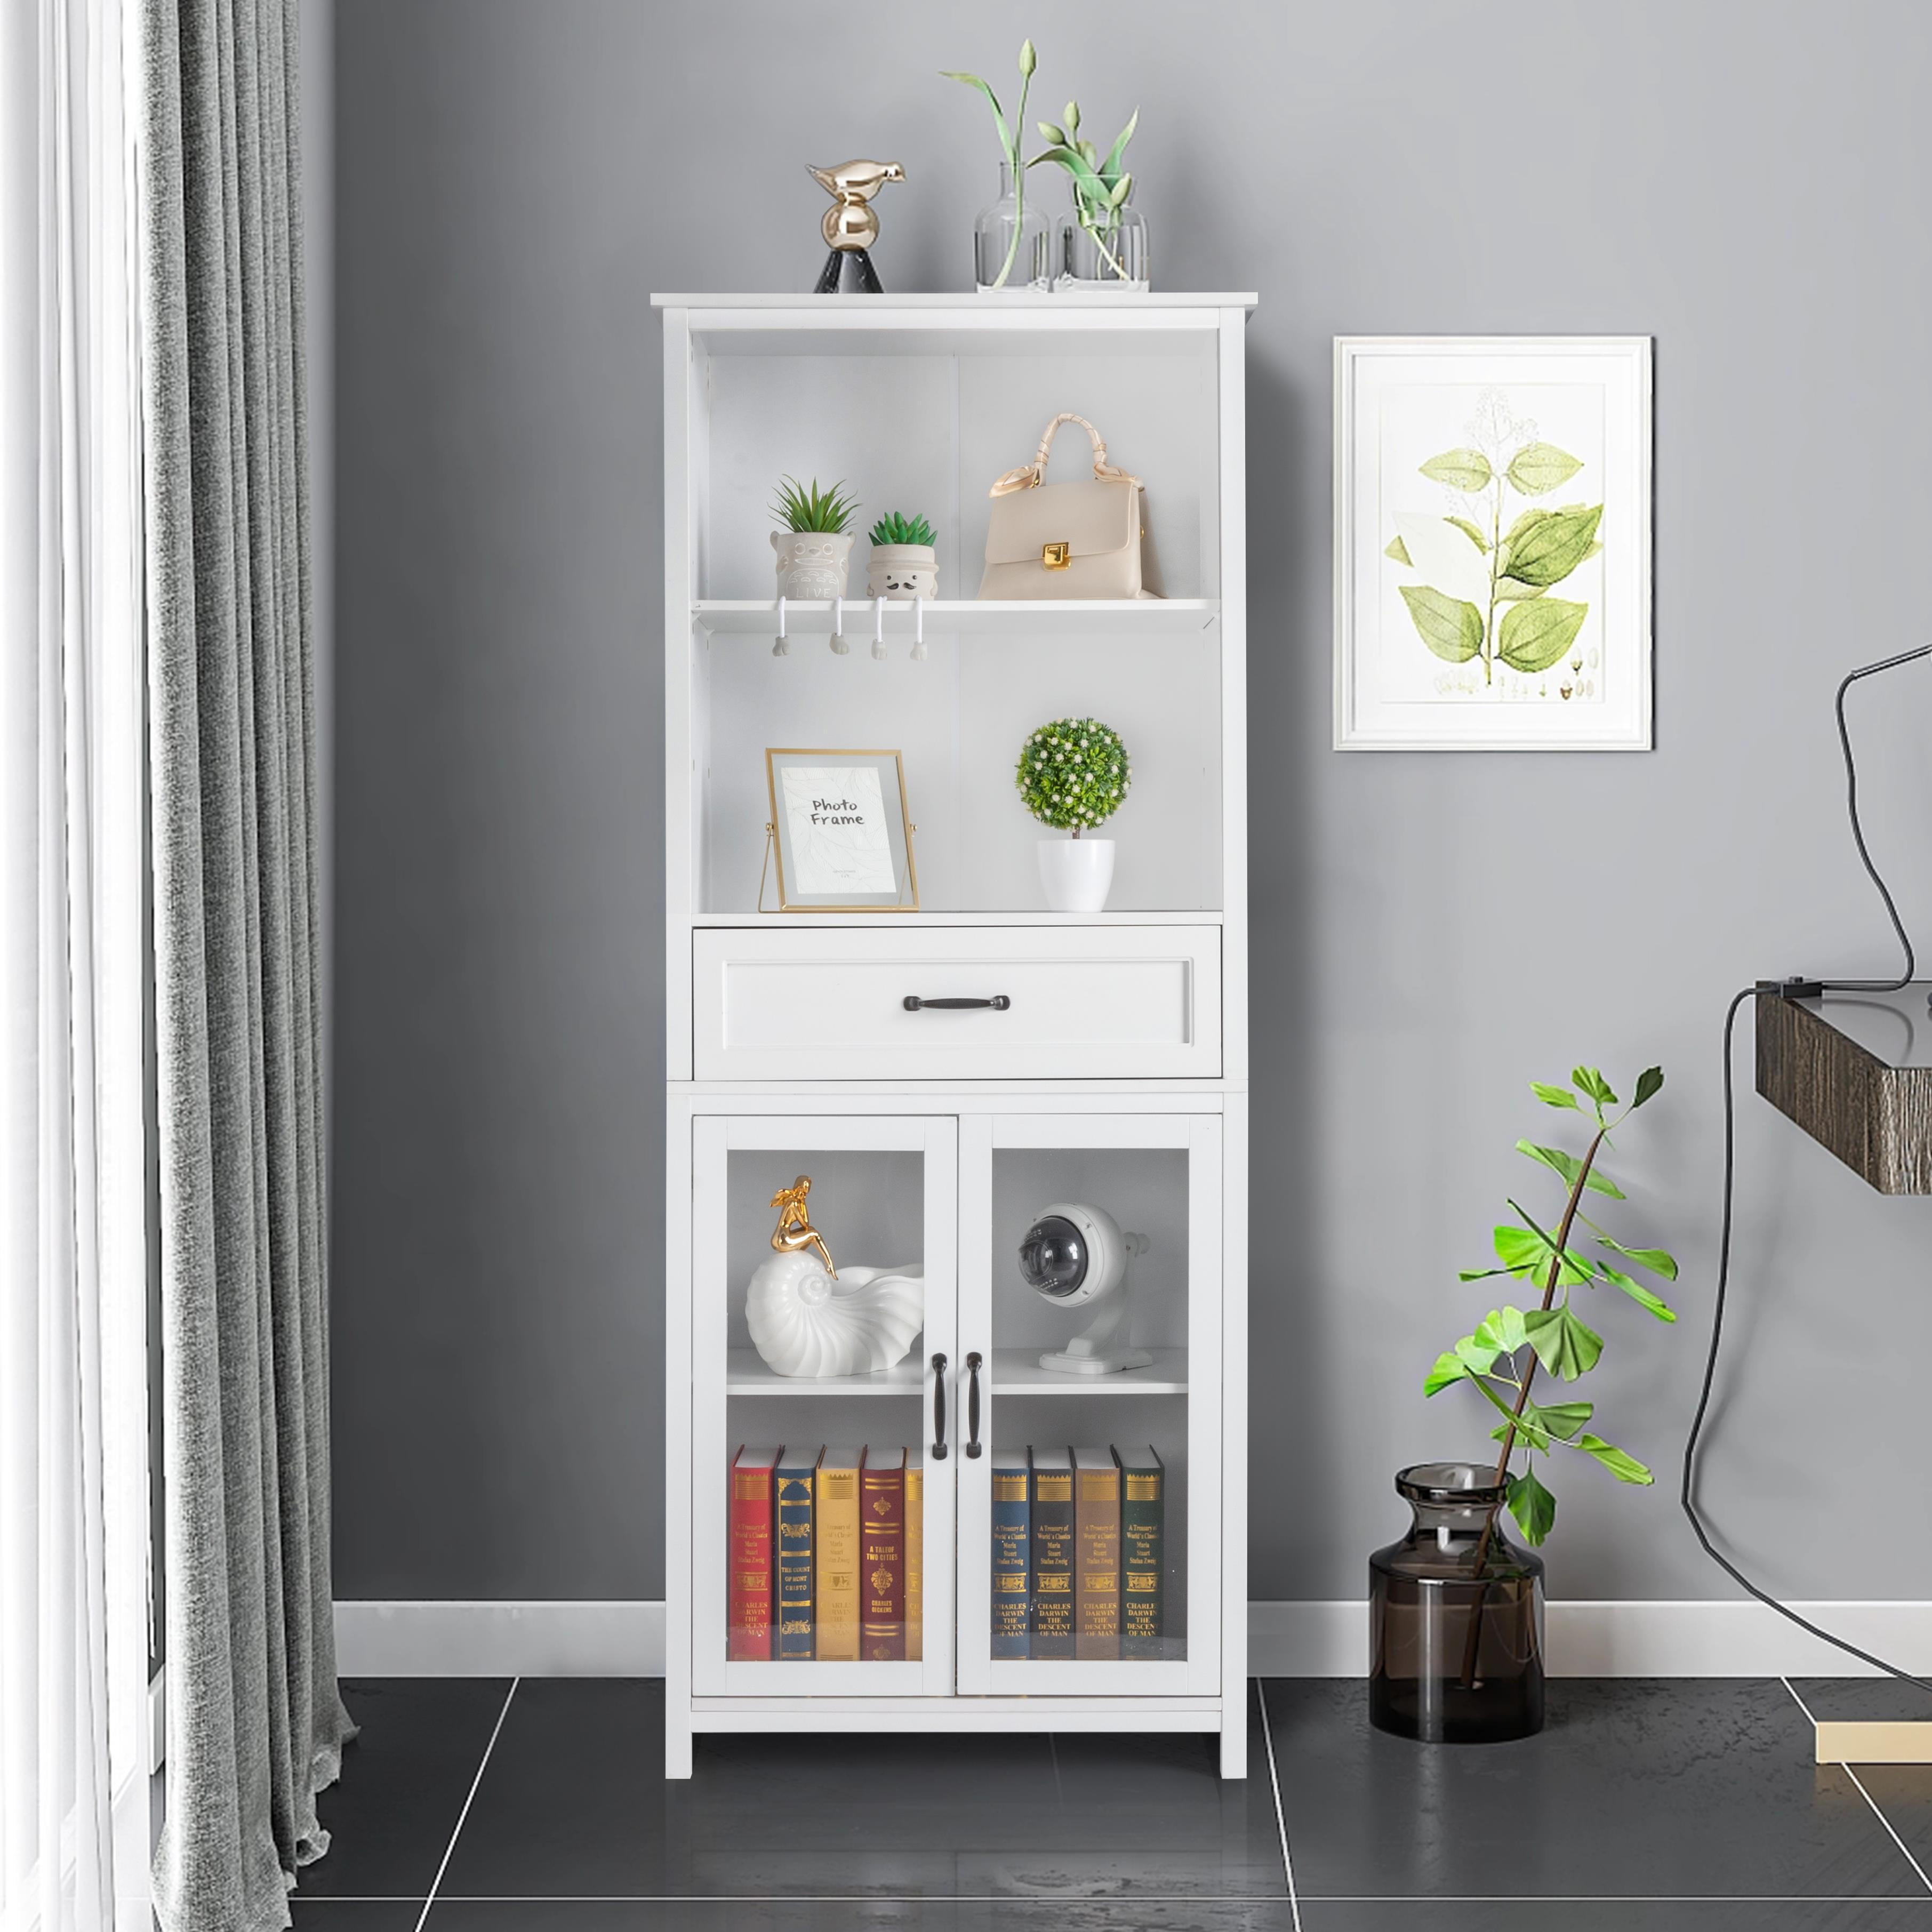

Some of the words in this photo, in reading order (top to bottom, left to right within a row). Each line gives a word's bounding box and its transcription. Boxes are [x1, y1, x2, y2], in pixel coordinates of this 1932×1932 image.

[796, 588, 831, 598] LIVE
[812, 798, 857, 811] Photo
[810, 813, 864, 825] Frame
